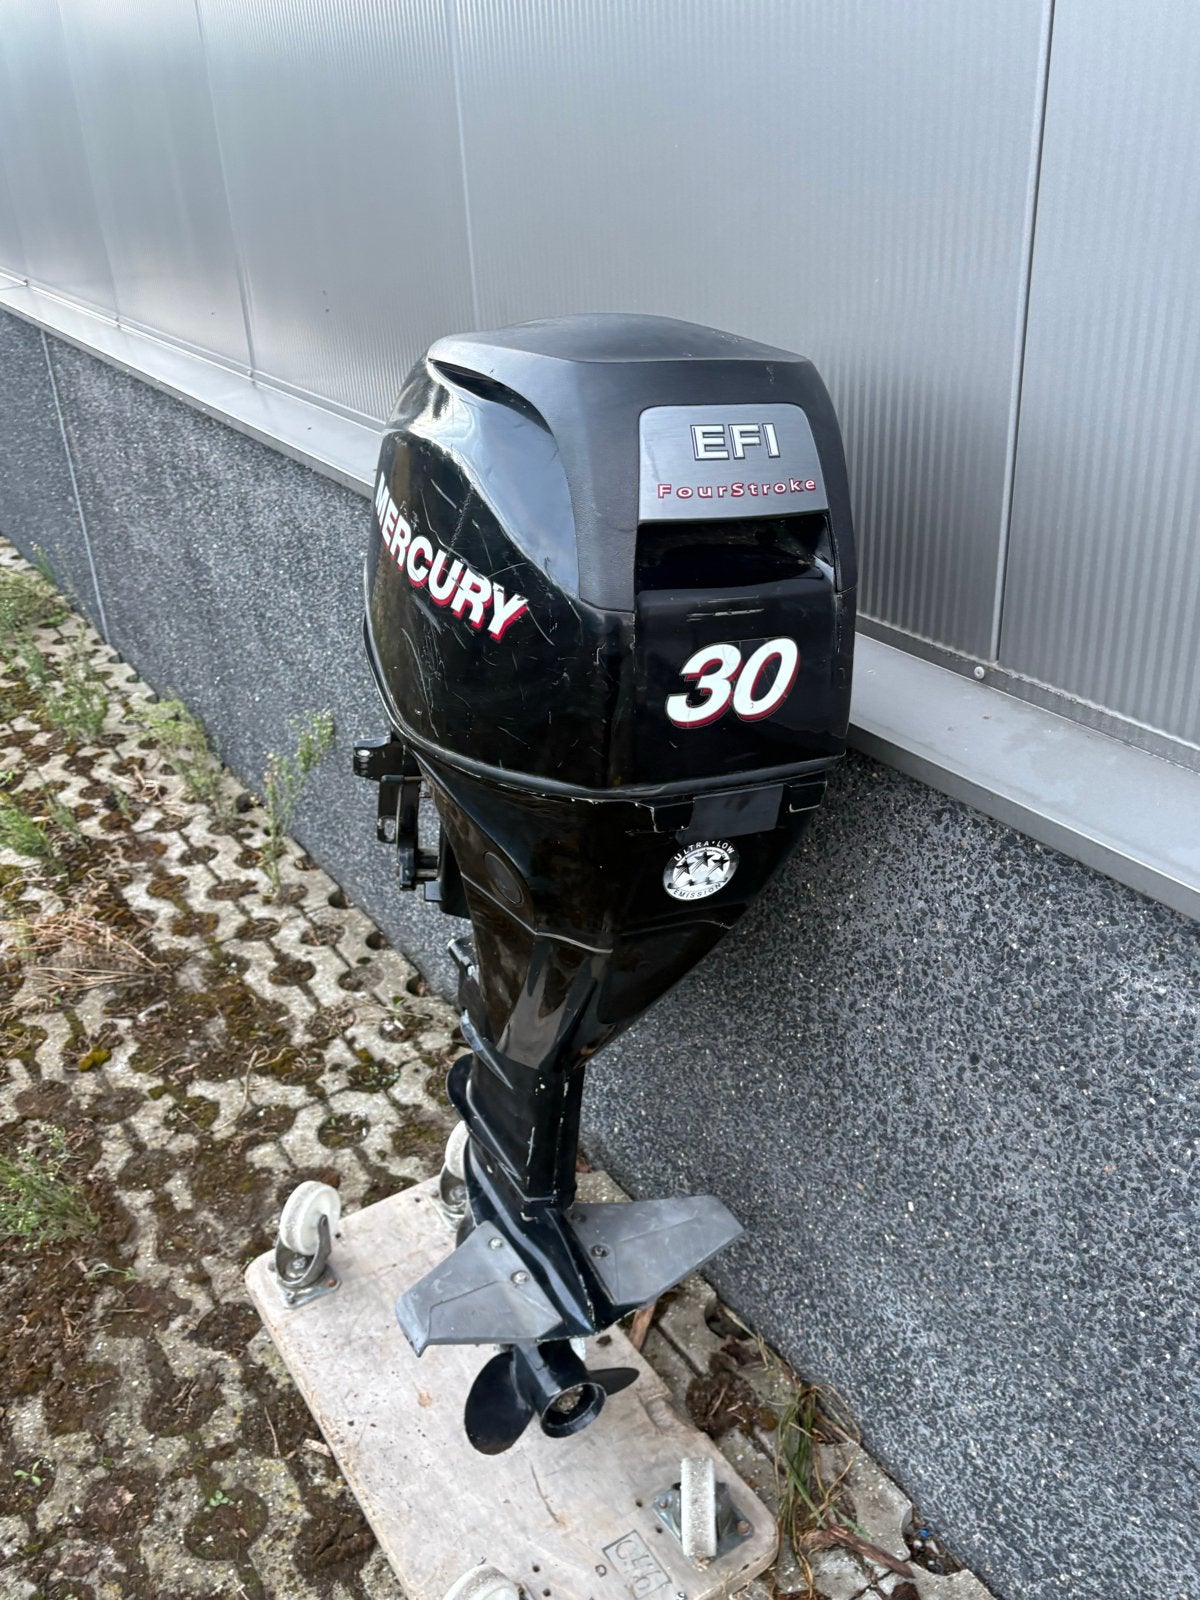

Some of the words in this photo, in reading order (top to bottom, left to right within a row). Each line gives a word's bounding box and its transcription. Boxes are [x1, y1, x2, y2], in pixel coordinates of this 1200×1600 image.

[690, 423, 780, 461] EFI
[657, 478, 816, 498] FourStroke
[375, 470, 529, 643] MERCURY
[665, 637, 799, 729] 30
[673, 882, 721, 899] EMISSION
